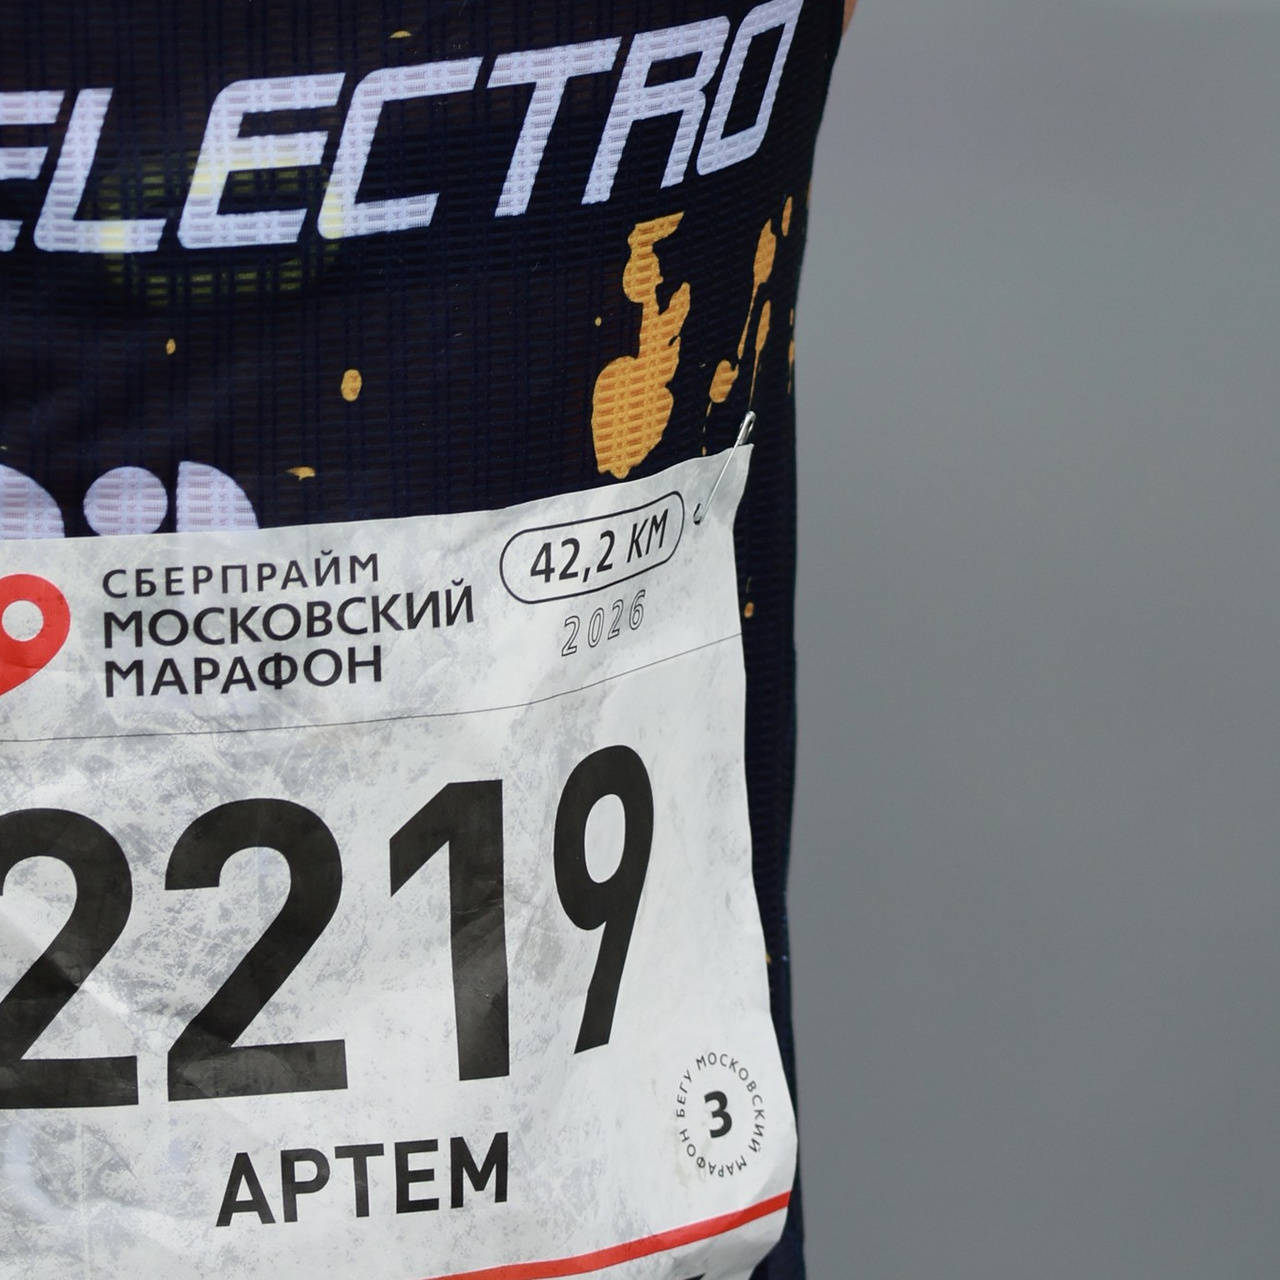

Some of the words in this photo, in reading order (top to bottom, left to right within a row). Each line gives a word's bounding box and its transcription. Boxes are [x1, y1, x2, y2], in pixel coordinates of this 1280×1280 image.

[102, 550, 379, 598] СБЕРПРАЙМ
[530, 529, 616, 583] 42,2
[626, 508, 669, 563] КМ
[103, 577, 474, 649] МОСКОВСКИЙ
[561, 589, 646, 657] 2026
[105, 644, 382, 698] МАРАФОН
[676, 1069, 693, 1118] БЕГУ
[695, 1052, 766, 1153] МОСКОВСКИЙ
[703, 1090, 733, 1139] 3
[215, 1130, 510, 1228] АРТЕМ
[678, 1127, 748, 1178] МАРАФОН
